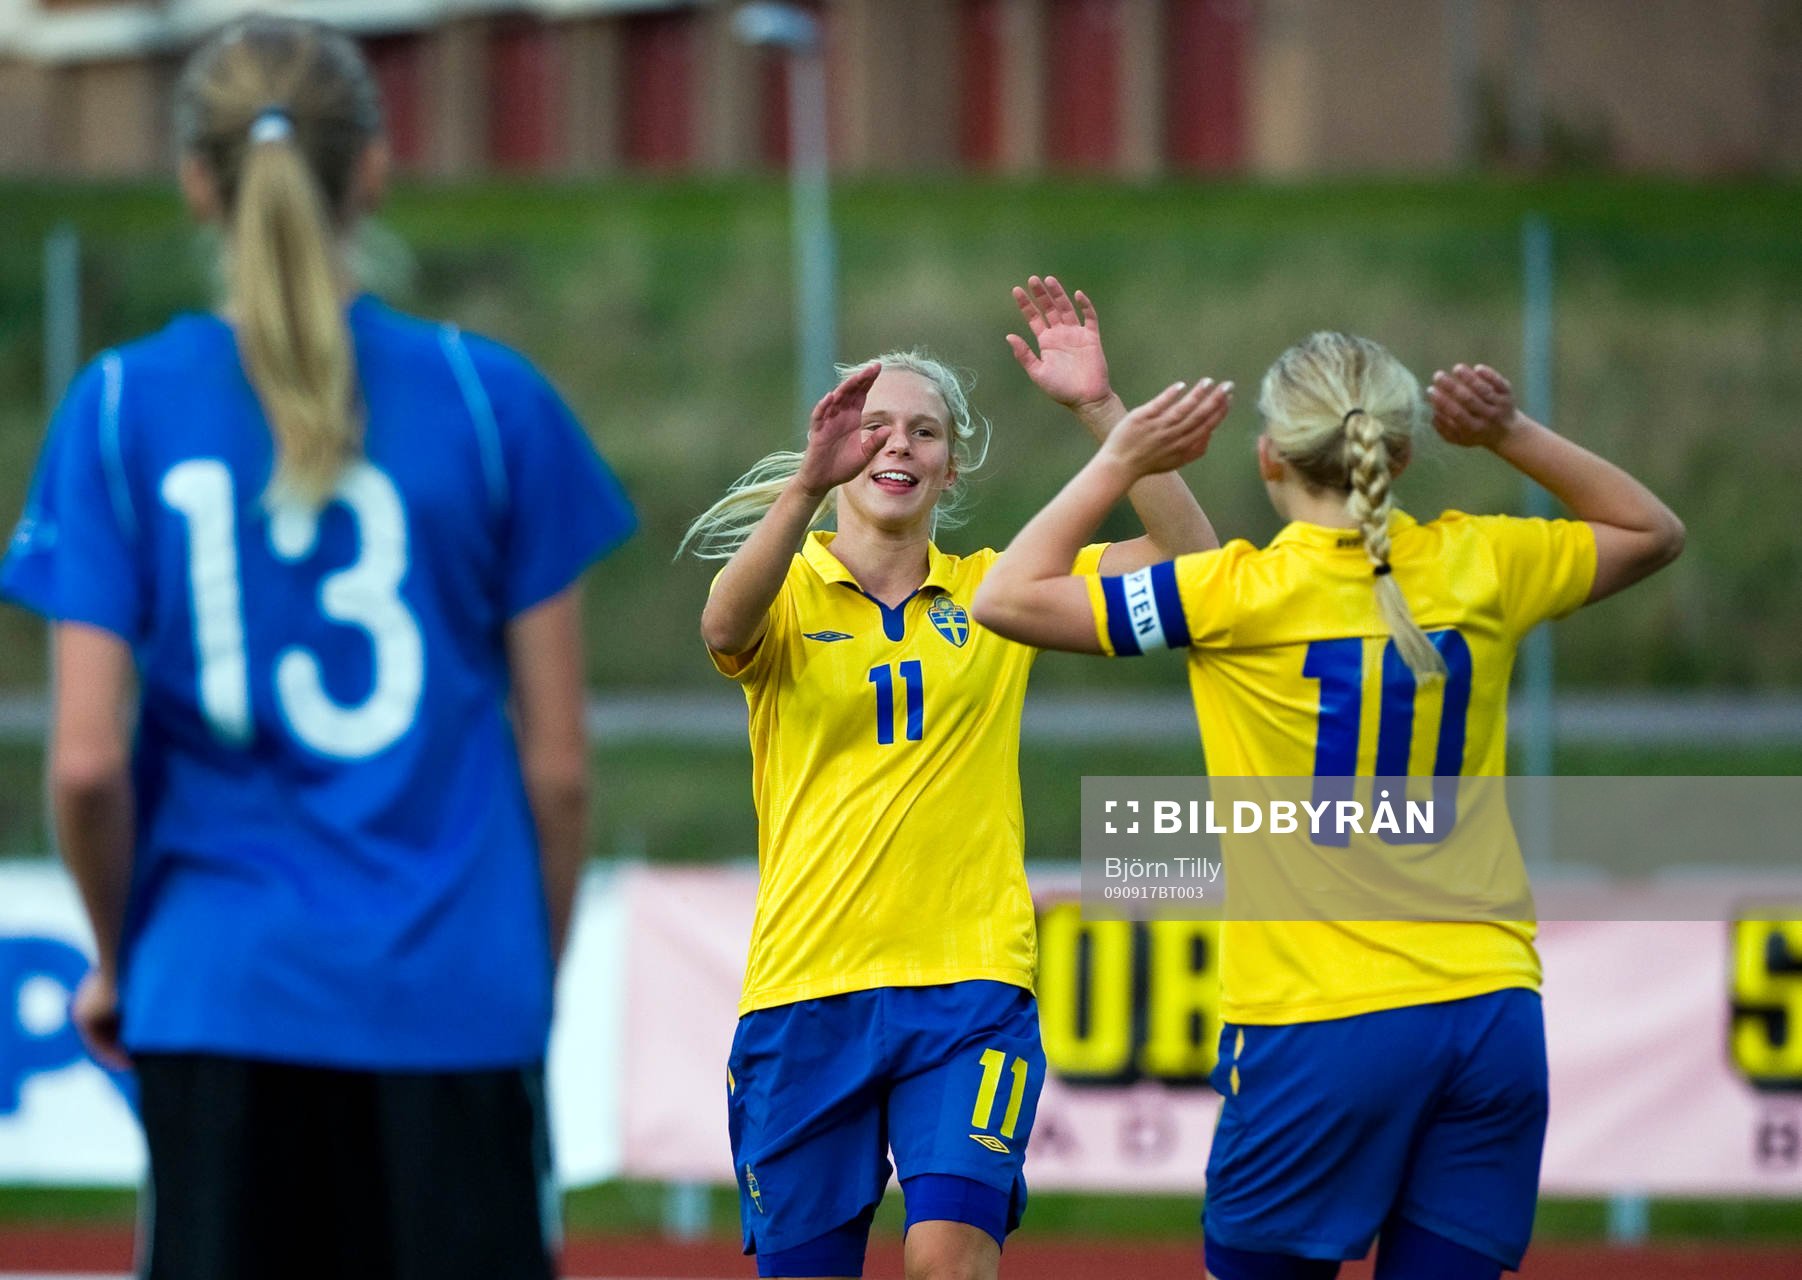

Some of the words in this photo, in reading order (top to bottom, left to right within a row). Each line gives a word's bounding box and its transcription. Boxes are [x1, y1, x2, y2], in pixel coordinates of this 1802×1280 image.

[162, 457, 425, 760] 13
[868, 659, 924, 745] 11
[1302, 628, 1472, 848] 10
[971, 1048, 1028, 1139] 11
